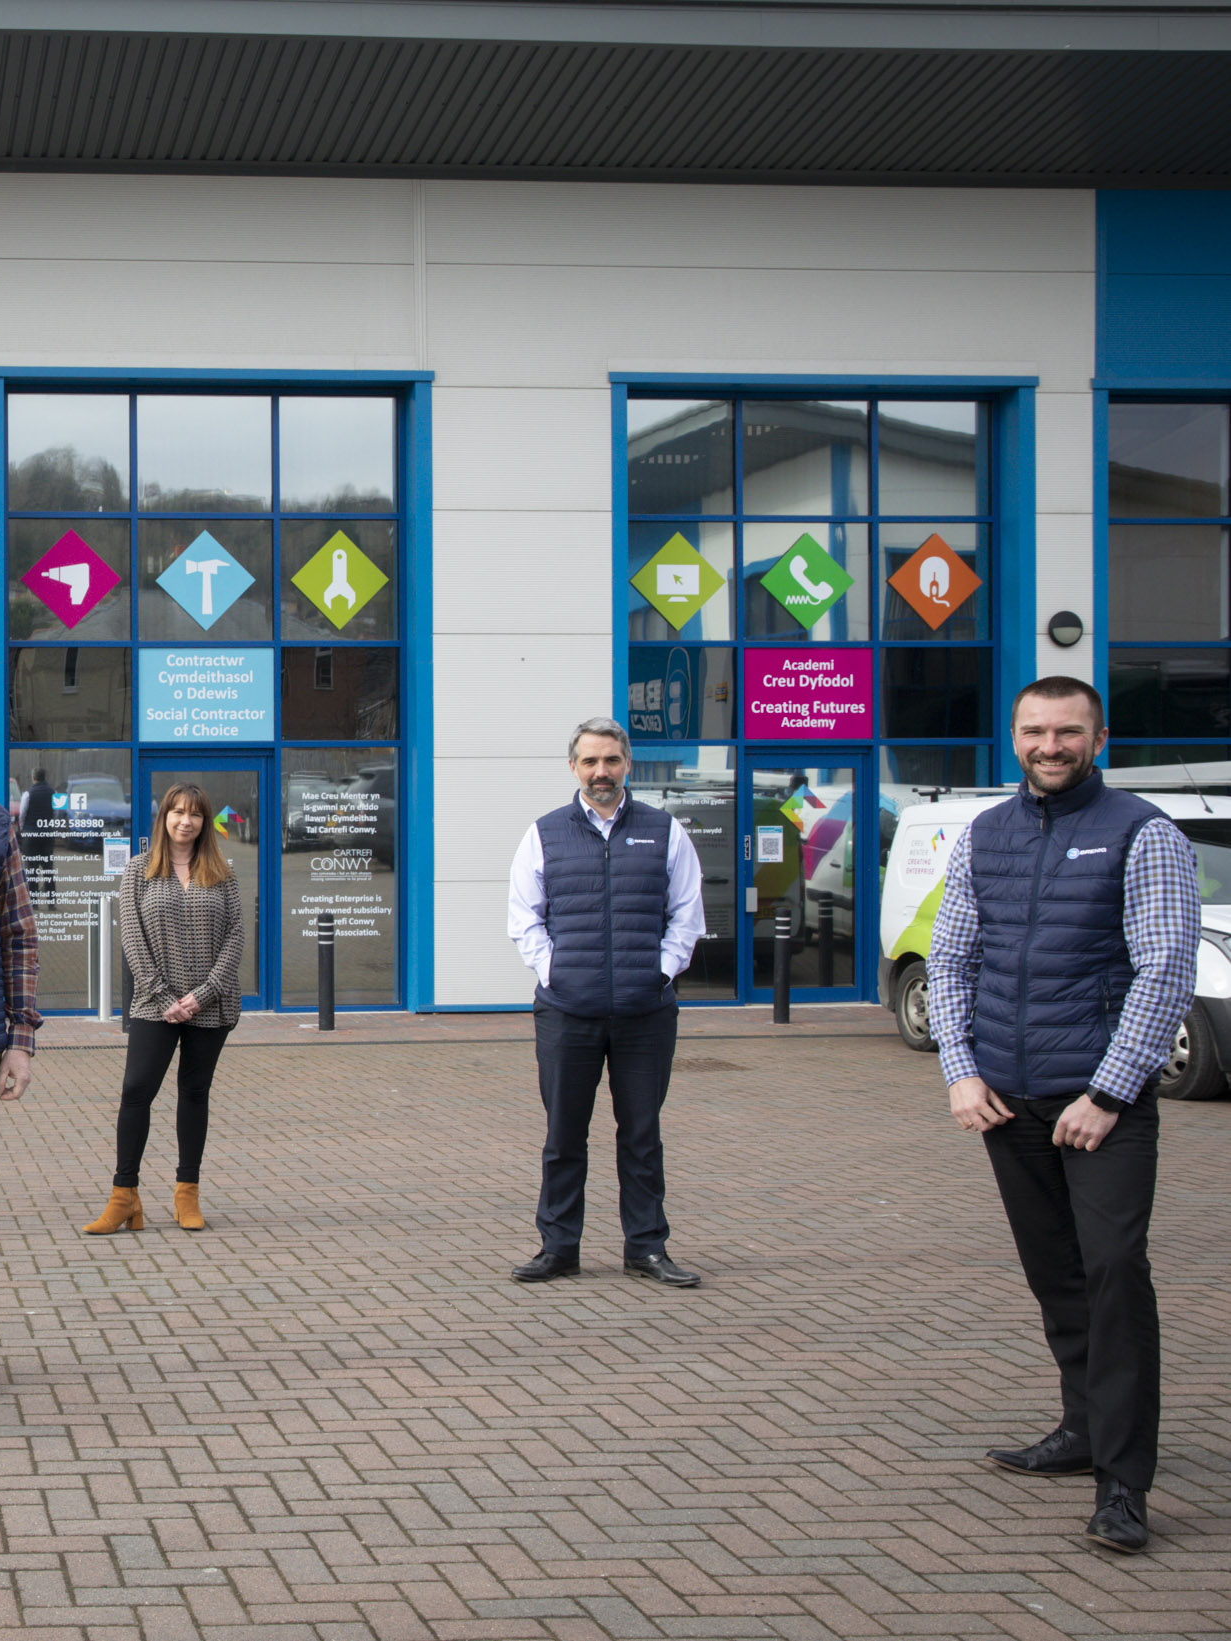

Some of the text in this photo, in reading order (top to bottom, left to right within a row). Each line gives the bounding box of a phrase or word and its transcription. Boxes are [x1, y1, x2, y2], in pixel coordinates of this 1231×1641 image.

[166, 654, 245, 667] Contractwr
[782, 659, 835, 671] Academi
[158, 670, 253, 686] Cymdeithasol
[763, 674, 854, 690] Creu Dyfodol
[173, 687, 239, 700] o Ddewis
[751, 700, 866, 717] Creating Futures
[146, 707, 266, 721] Social Contractor
[780, 716, 836, 730] Academy
[174, 723, 239, 737] of Choice
[302, 792, 320, 800] Mae
[321, 792, 339, 800] Creu
[340, 792, 369, 800] Menter
[303, 803, 338, 812] is-gwmni
[356, 803, 379, 811] eiddo
[305, 814, 377, 823] llawn i Gymdeithas
[36, 819, 104, 828] 01492 588980
[20, 831, 121, 839] www.creatingenterprise.org.uk
[318, 826, 348, 834] Cartrefi
[349, 826, 377, 835] Conwy.
[333, 849, 373, 857] CARTREFI
[21, 855, 49, 863] Creating
[310, 857, 372, 871] CONWY
[301, 894, 382, 904] Creating Enterprise is
[298, 906, 324, 914] wholly
[353, 906, 392, 915] subsidiary
[50, 920, 72, 928] Conwy
[349, 918, 375, 926] Conwy
[335, 929, 381, 937] Association.
